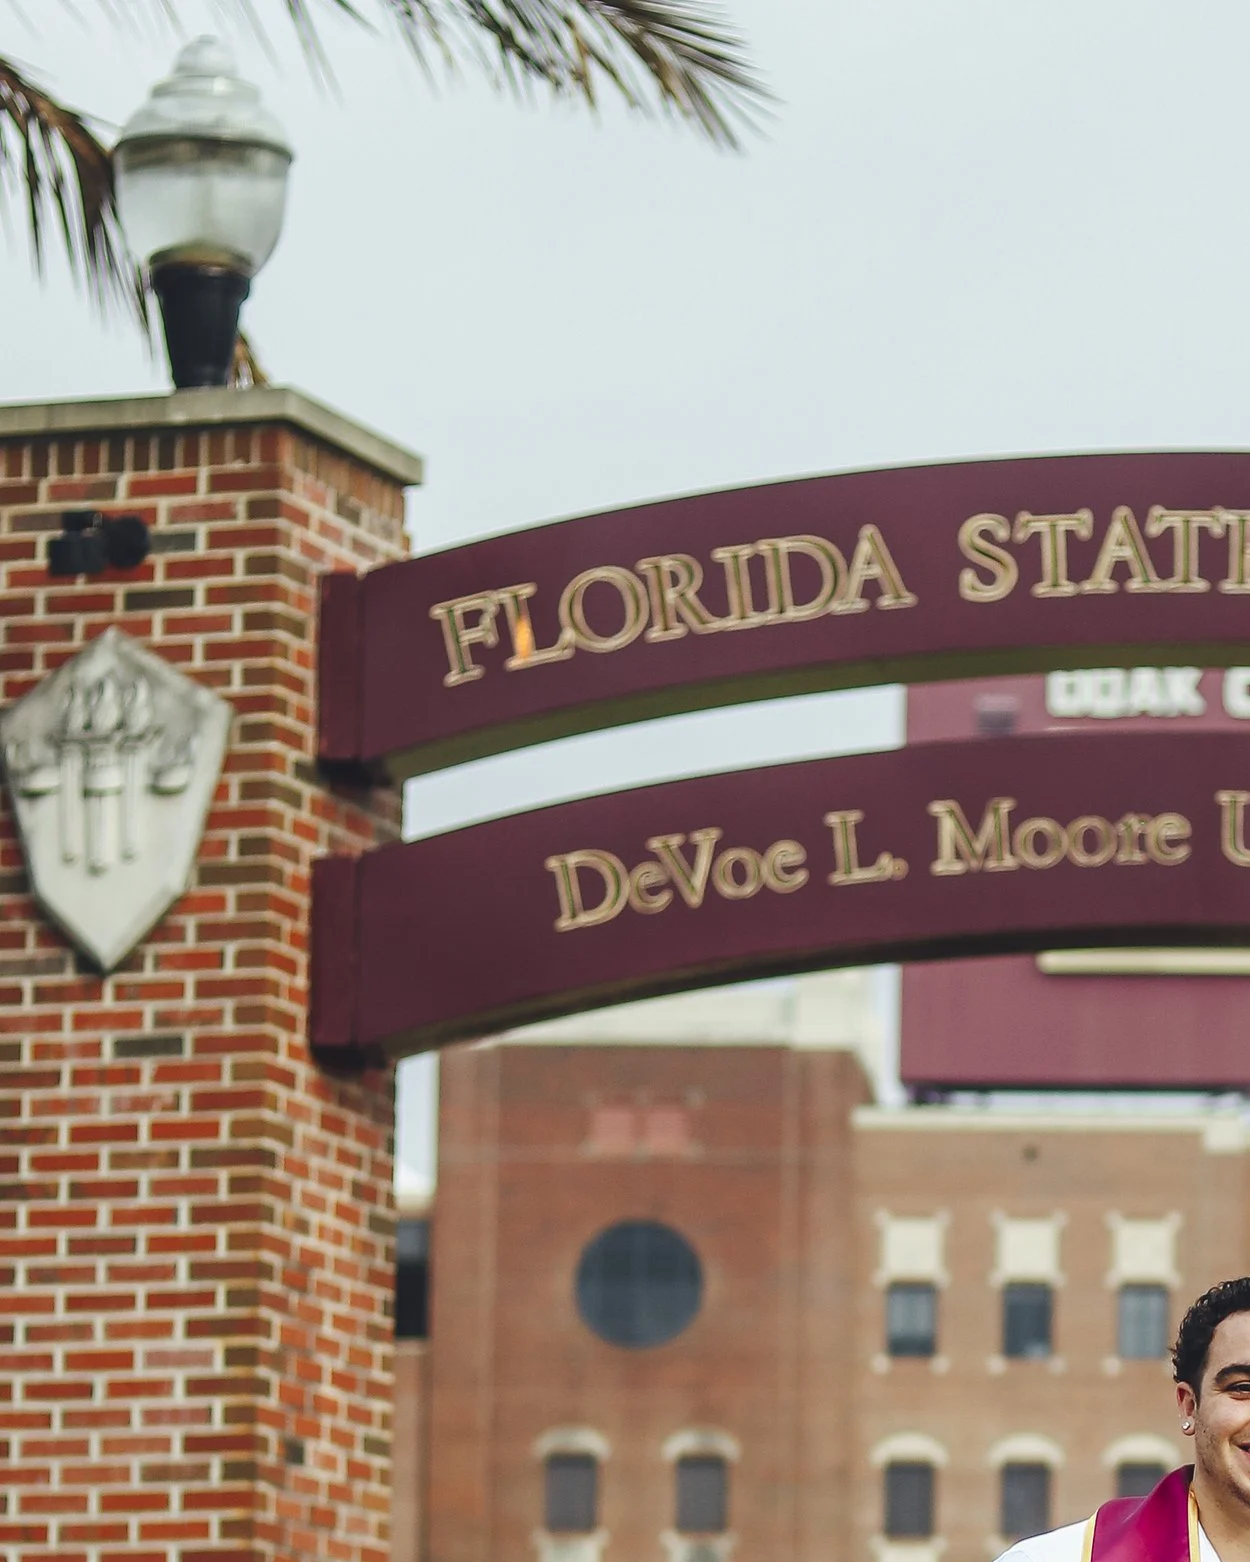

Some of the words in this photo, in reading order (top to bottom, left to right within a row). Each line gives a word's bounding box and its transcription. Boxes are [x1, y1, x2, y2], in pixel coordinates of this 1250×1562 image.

[430, 524, 917, 687] FLORIDA
[545, 827, 808, 932] DeVoe
[825, 810, 909, 886] L.
[928, 797, 1192, 877] Moore
